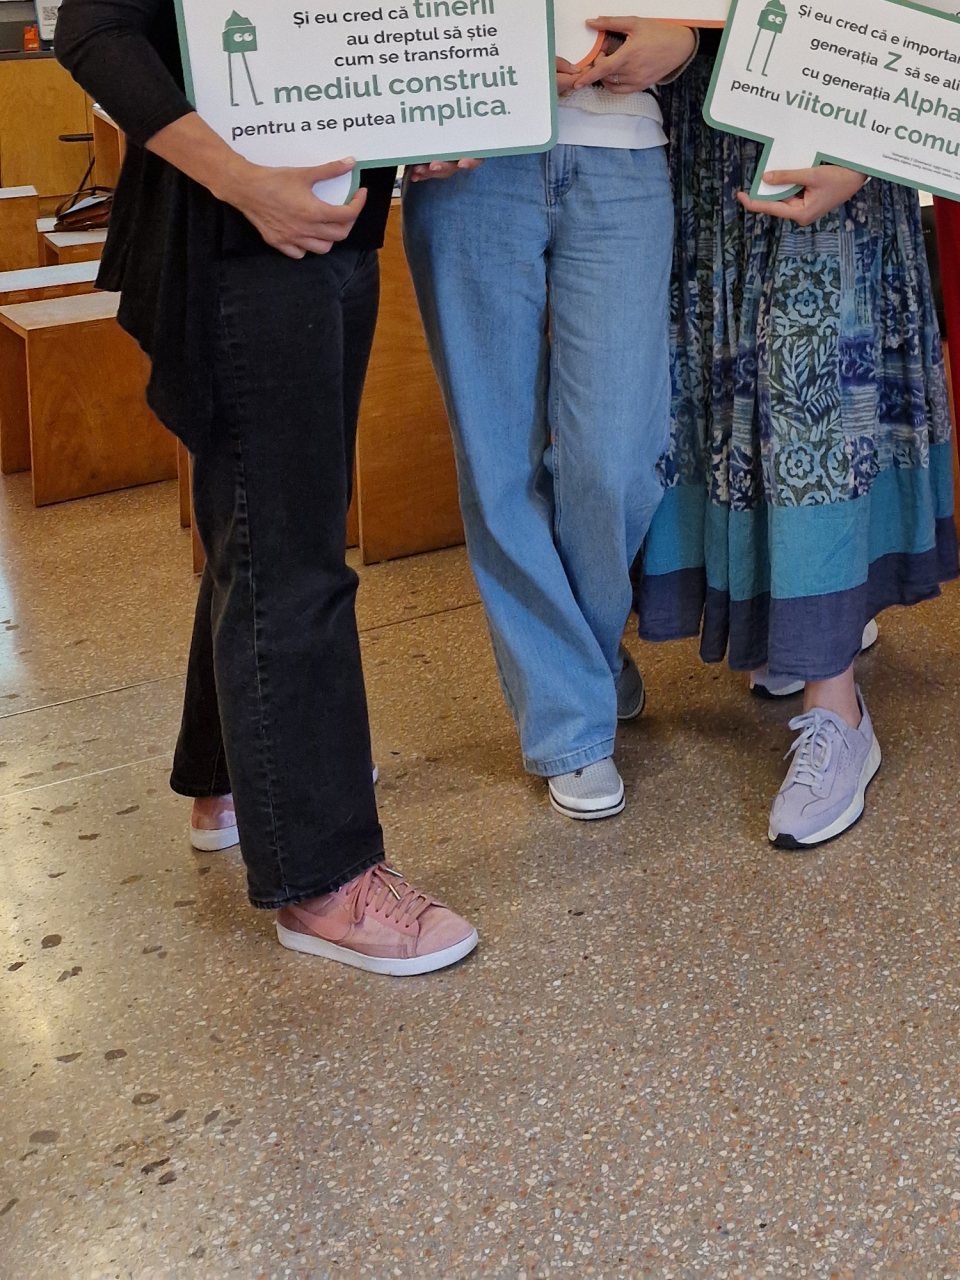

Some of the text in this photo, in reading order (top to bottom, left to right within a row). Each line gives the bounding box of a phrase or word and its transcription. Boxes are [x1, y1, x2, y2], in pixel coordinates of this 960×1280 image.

[293, 11, 310, 29] Și
[314, 12, 338, 24] eu
[342, 7, 384, 23] cred
[387, 6, 409, 20] că
[346, 24, 498, 46] au dreptul să știe
[798, 4, 813, 19] Și
[814, 12, 833, 25] eu
[835, 18, 869, 36] cred
[870, 29, 888, 42] că
[890, 35, 900, 45] e
[334, 43, 500, 67] cum se transformă
[809, 38, 878, 66] generația
[883, 51, 903, 72] Z
[904, 66, 921, 80] să
[923, 73, 940, 85] se
[274, 65, 518, 104] mediul construit
[801, 67, 820, 80] cu
[821, 73, 891, 102] generația
[231, 96, 511, 141] pentru a se putea implica.
[730, 80, 781, 102] pentru
[786, 90, 868, 129] viitorul
[871, 119, 892, 135] lor
